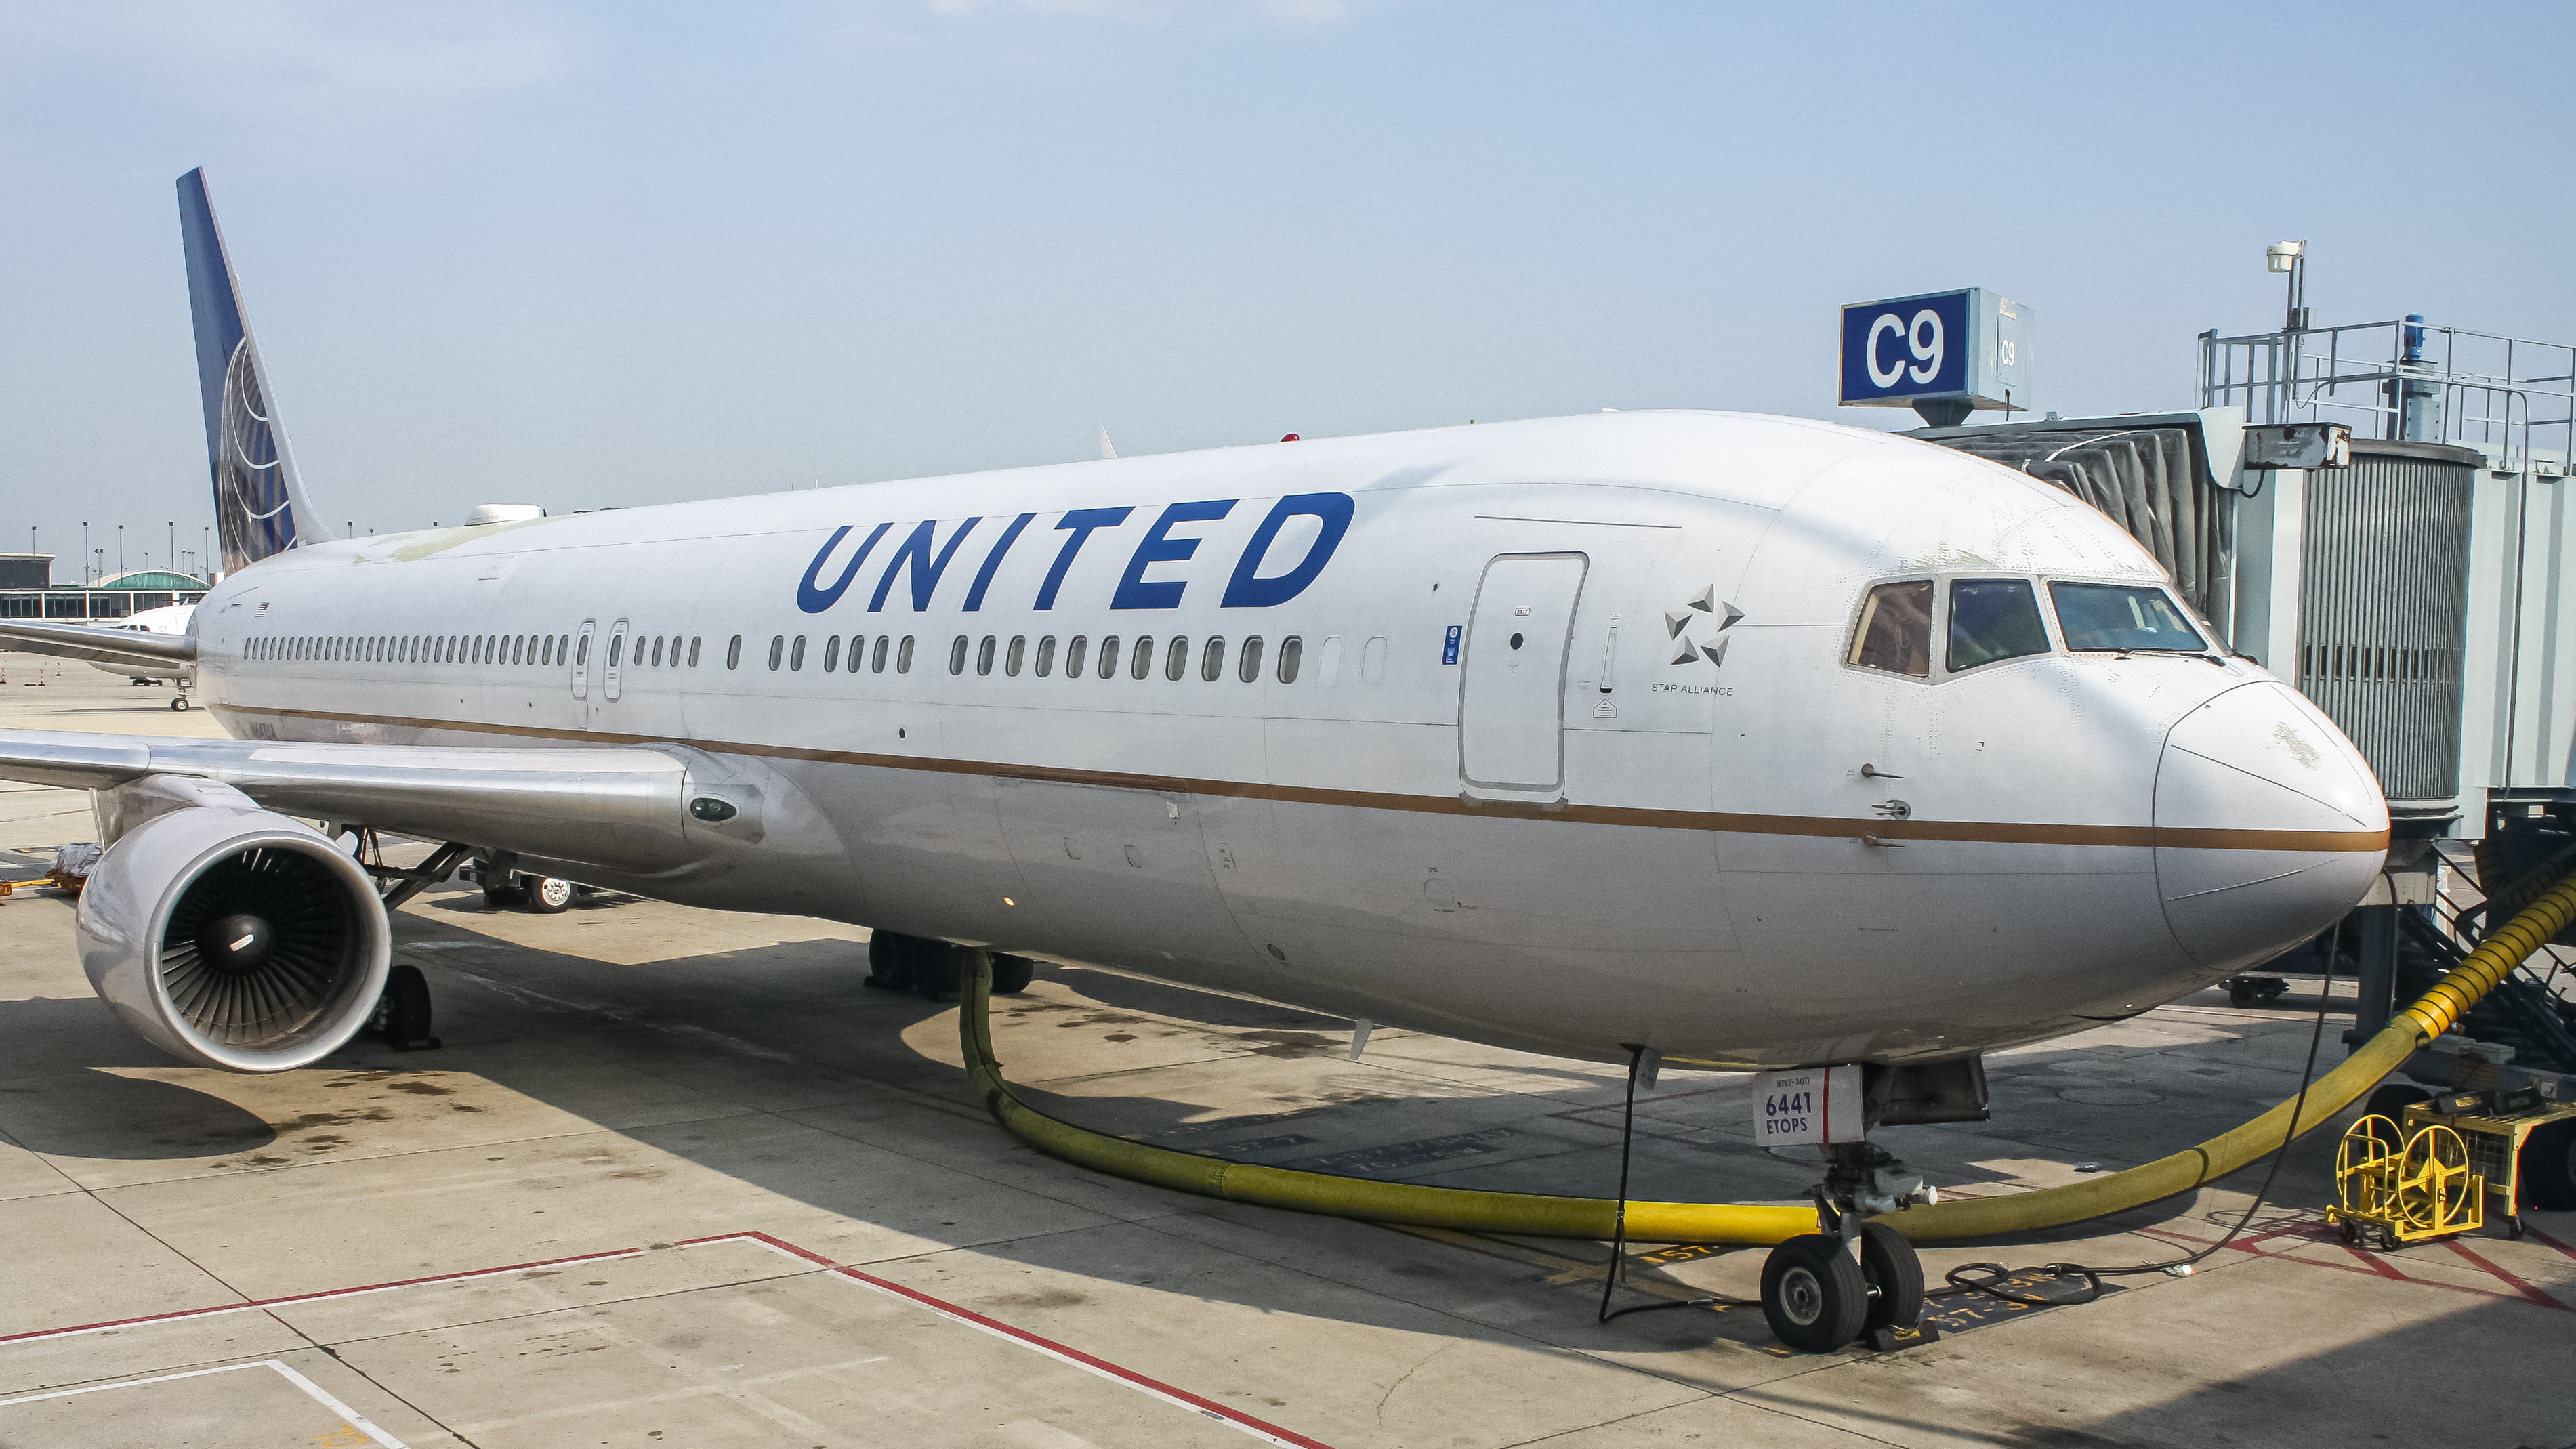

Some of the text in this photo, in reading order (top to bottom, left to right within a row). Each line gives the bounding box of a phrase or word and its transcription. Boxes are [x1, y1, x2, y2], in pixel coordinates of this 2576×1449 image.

[1866, 309, 1944, 388] C9
[2001, 339, 2015, 367] C9
[796, 492, 1356, 614] UNITED
[1651, 683, 1733, 696] STAR ALLIANCE
[1766, 1091, 1812, 1117] 6441
[1766, 1116, 1808, 1135] ETOPS
